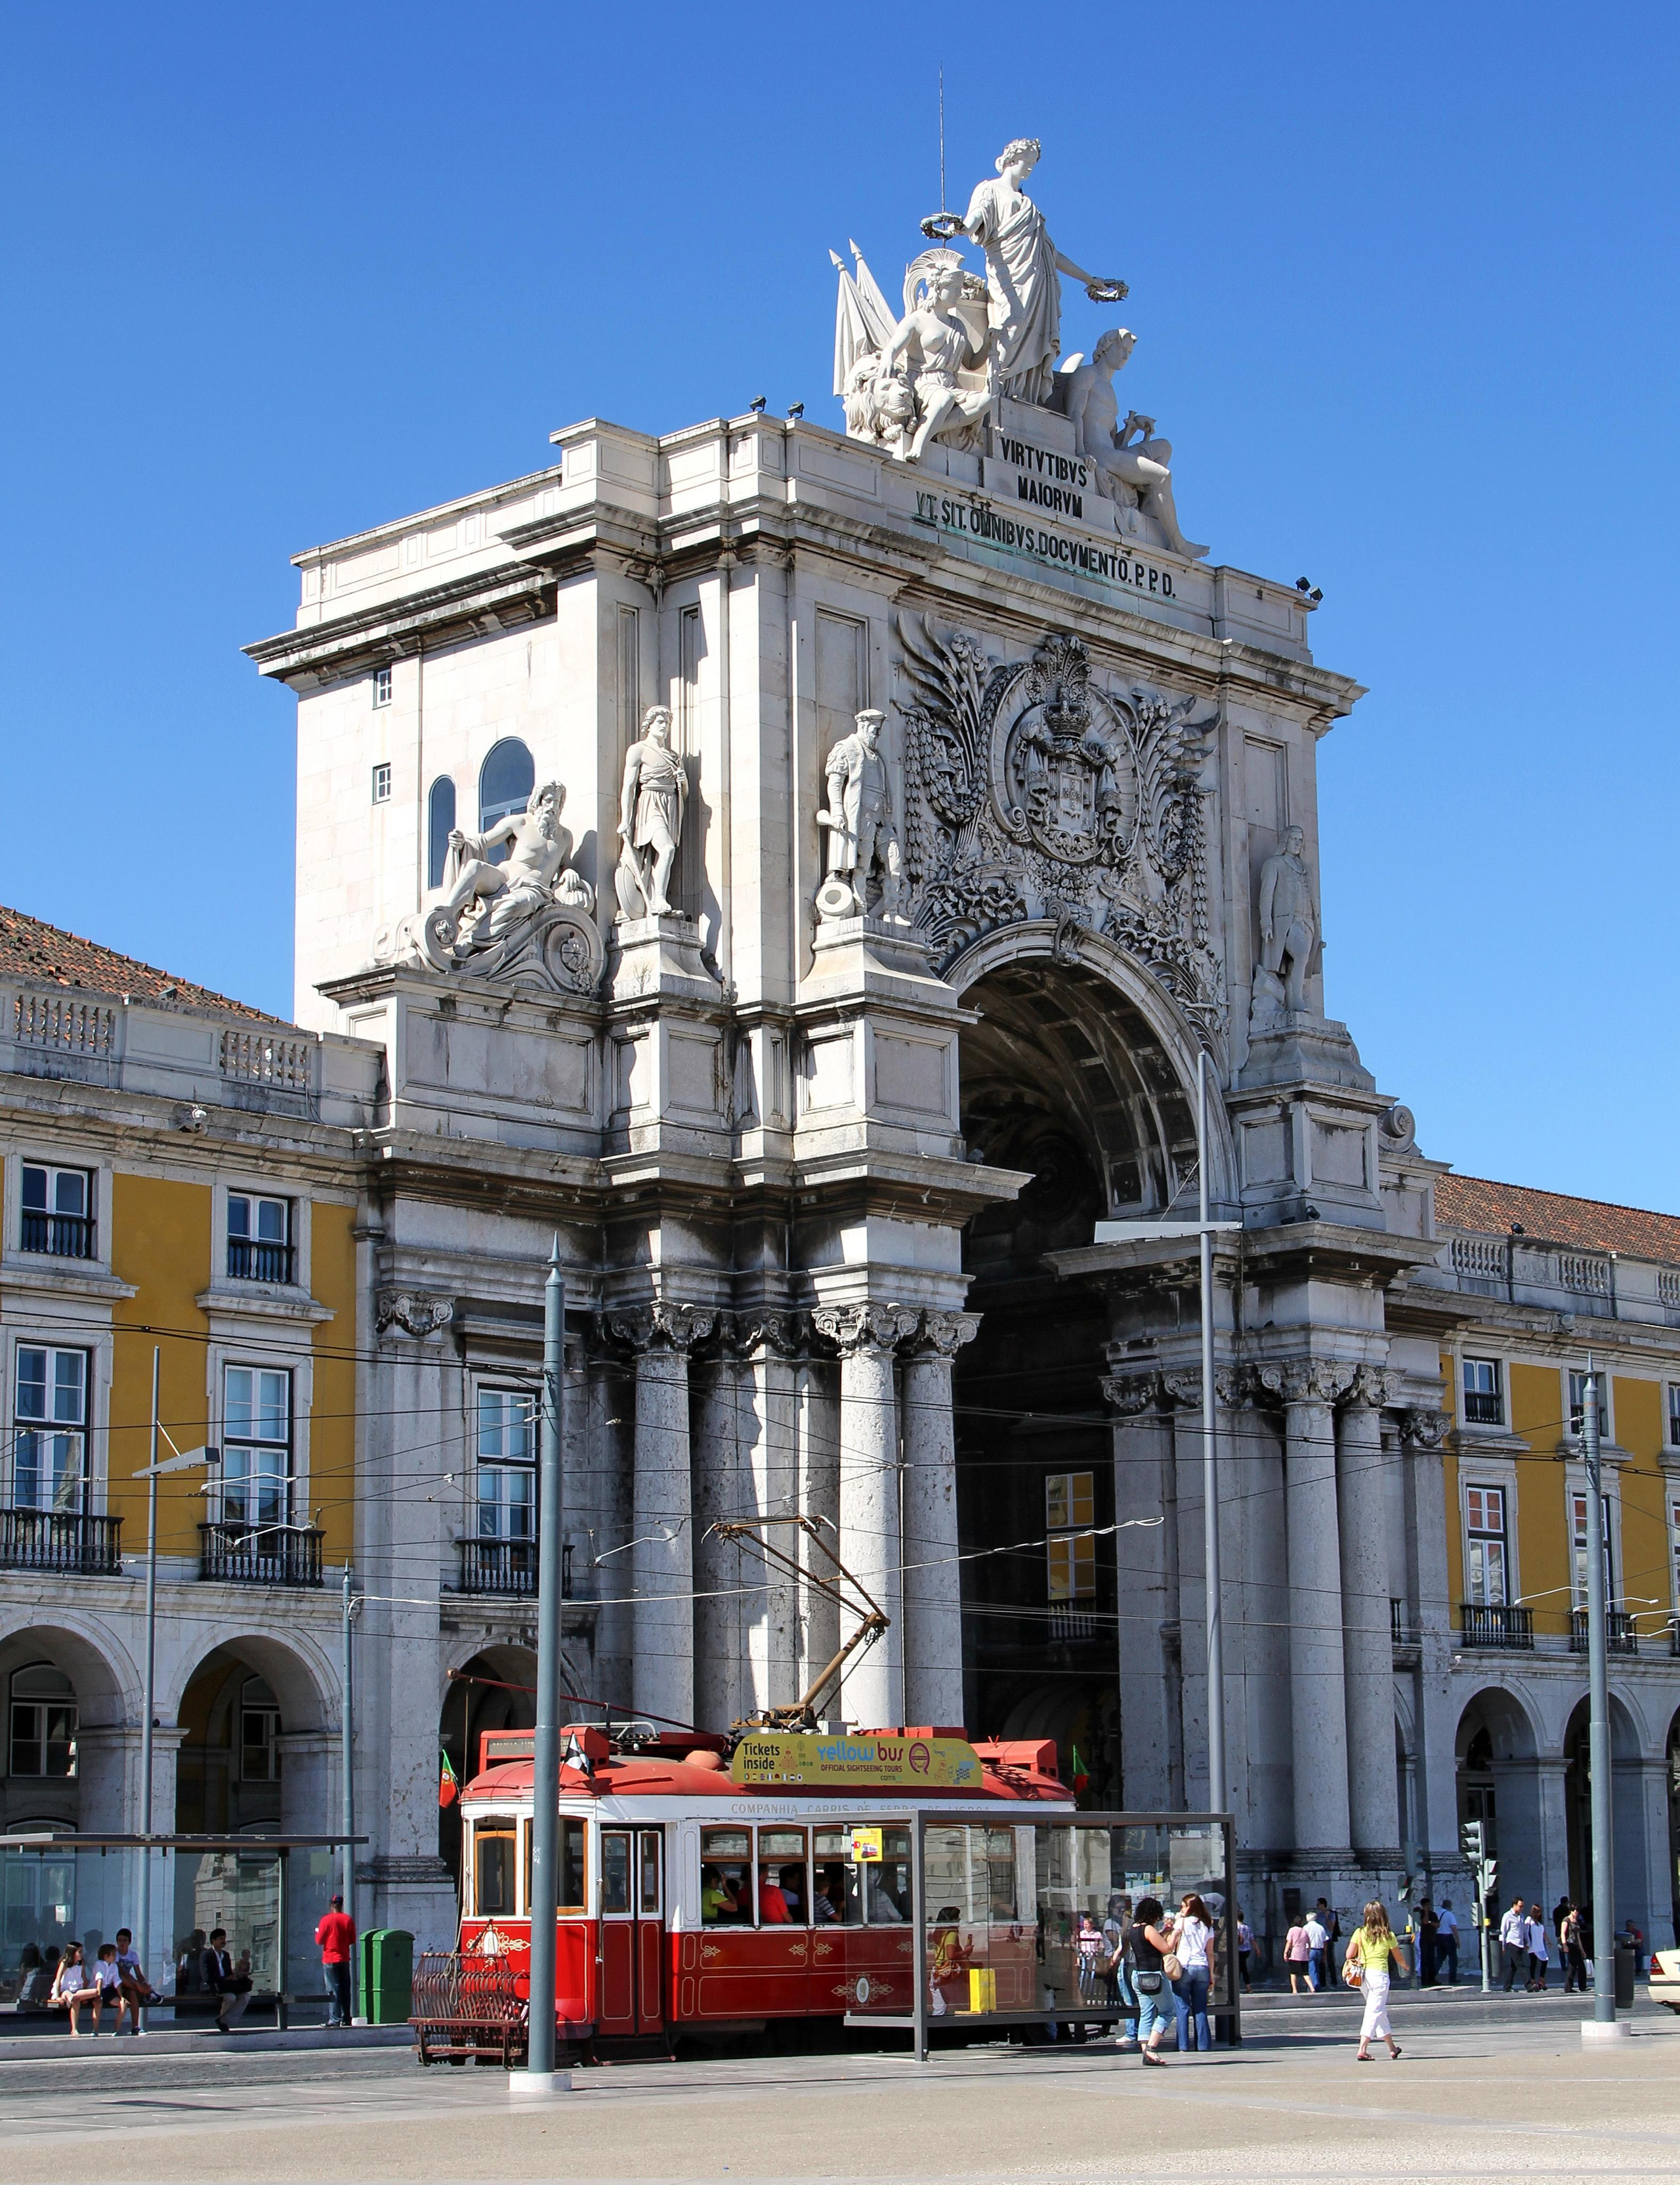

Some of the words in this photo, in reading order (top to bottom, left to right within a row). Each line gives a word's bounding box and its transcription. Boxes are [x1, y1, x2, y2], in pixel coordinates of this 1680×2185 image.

[1001, 436, 1087, 487] VIRTVTIBVS
[1018, 475, 1082, 519] MAIORVM
[743, 1742, 780, 1756] Tickets
[877, 1741, 904, 1761] bus
[744, 1756, 775, 1770] inside
[731, 1804, 798, 1814] COMPANHIA
